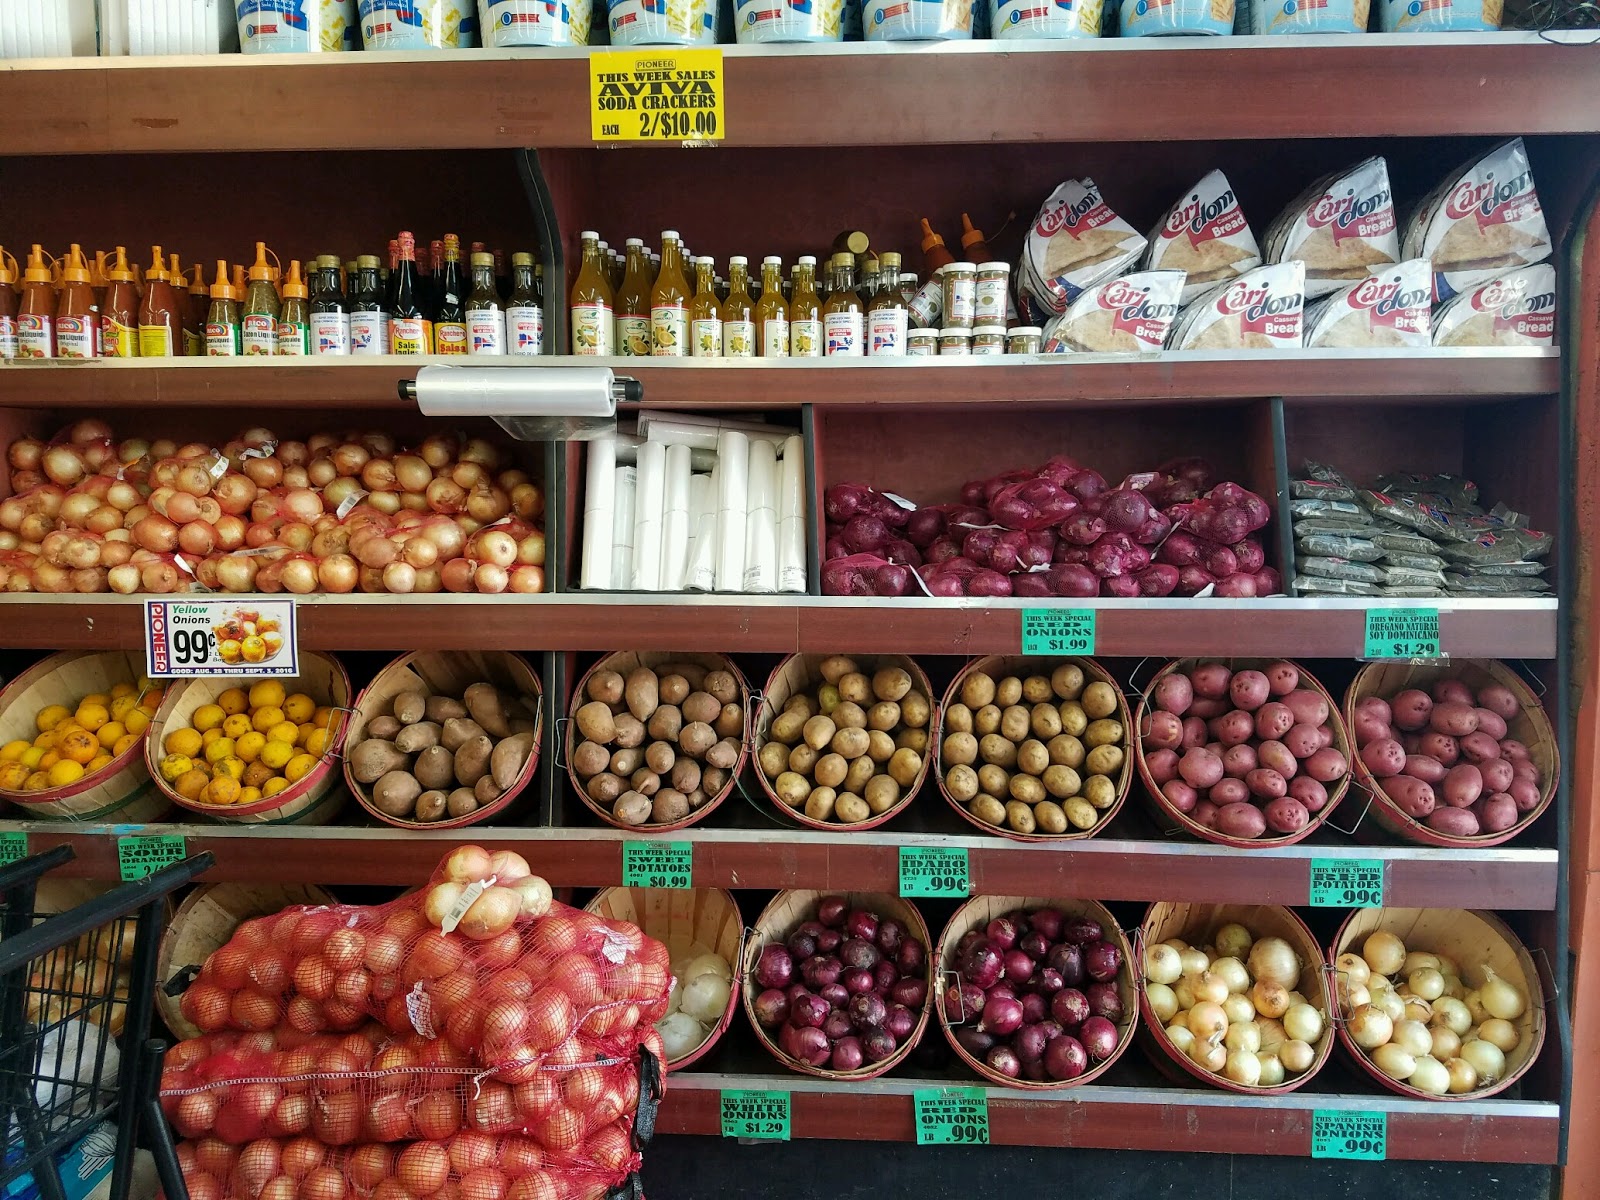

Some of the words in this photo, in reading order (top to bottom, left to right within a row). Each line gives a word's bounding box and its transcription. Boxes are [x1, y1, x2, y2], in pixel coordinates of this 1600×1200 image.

[636, 60, 674, 69] PIONEER
[596, 72, 629, 83] THIS
[633, 71, 672, 82] WEEK
[676, 70, 716, 80] SALES
[598, 81, 715, 96] AVIVA
[598, 96, 637, 110] SODA
[641, 95, 716, 109] CRACKERS
[639, 111, 717, 138] 2/$10.00
[602, 124, 620, 135] EACH
[1212, 214, 1245, 238] Bread
[1358, 216, 1394, 236] Bread
[1518, 321, 1554, 333] Bread
[398, 341, 421, 349] Salsa
[440, 344, 466, 352] Salsa
[172, 605, 209, 614] Yellow
[172, 615, 211, 624] Onions
[1369, 623, 1404, 631] OREGANO
[1406, 623, 1438, 631] NATURAL
[1026, 628, 1092, 636] ONIONS
[1369, 631, 1385, 640] SOY
[1387, 631, 1439, 640] DOMINICANO
[151, 604, 166, 672] PIONEER
[1049, 639, 1087, 650] $1.99
[1393, 643, 1435, 655] $1.29
[121, 848, 183, 858] SOUR
[628, 864, 691, 873] POTATOES
[902, 860, 966, 868] IDAHO
[902, 867, 966, 876] POTATOES
[650, 876, 687, 888] $0.99
[924, 877, 967, 892] .99¢
[1312, 881, 1381, 889] POTATOES
[1336, 890, 1381, 905] .99¢
[958, 1098, 985, 1106] SPECIAL
[723, 1104, 786, 1112] WHITE
[722, 1111, 787, 1120] ONIONS
[921, 1115, 987, 1124] ONIONS
[745, 1122, 783, 1133] $1.29
[1315, 1122, 1383, 1131] SPANISH
[924, 1133, 934, 1141] LB
[946, 1125, 988, 1144] .99¢
[1315, 1130, 1383, 1139] ONIONS
[1338, 1139, 1383, 1155] .99¢
